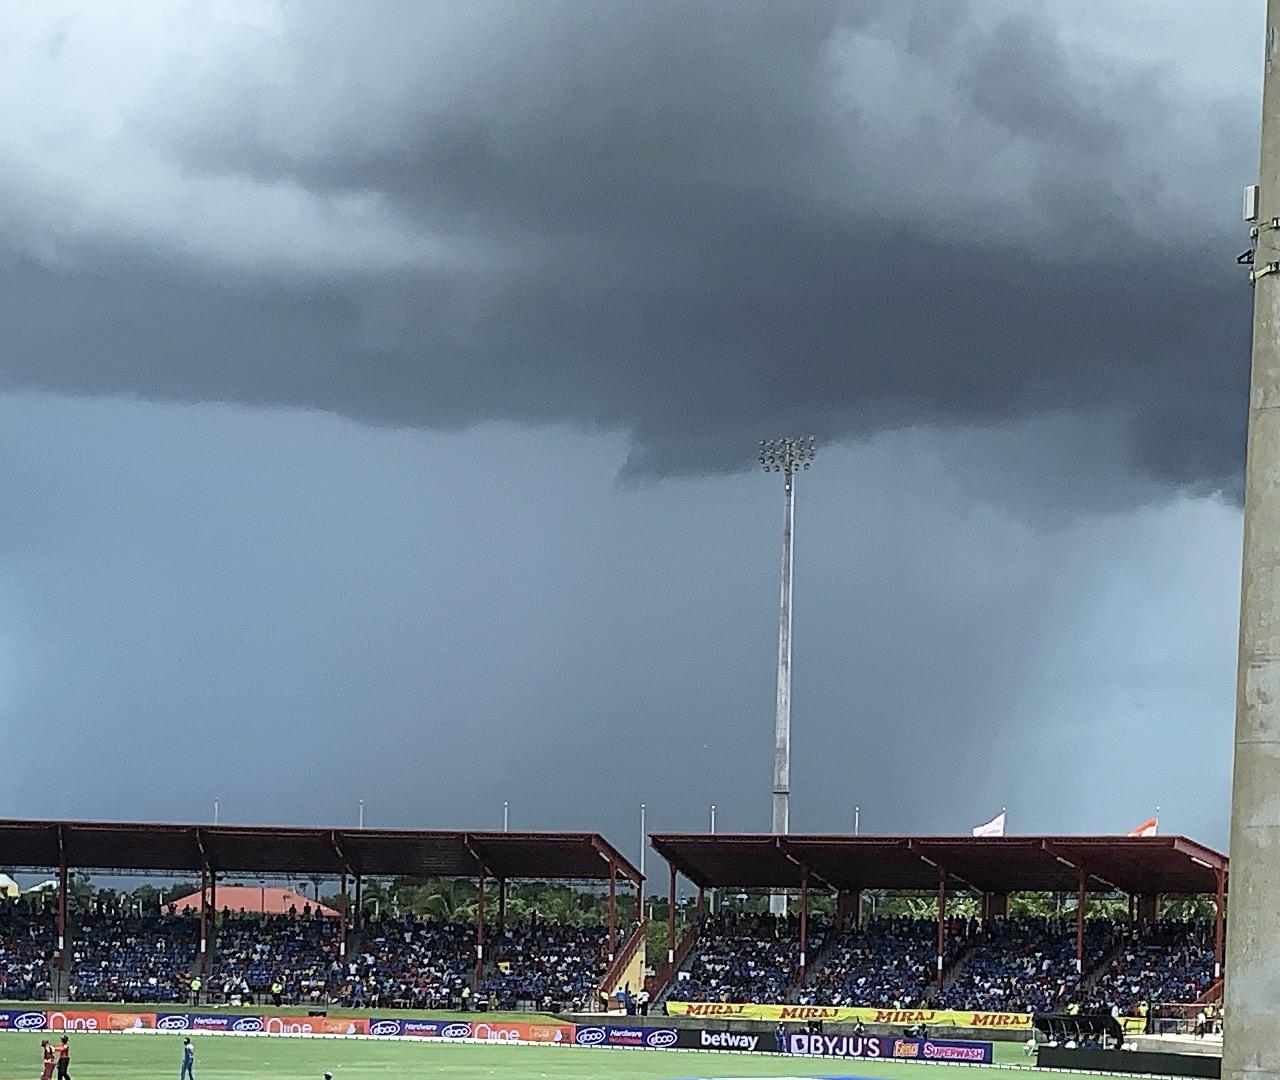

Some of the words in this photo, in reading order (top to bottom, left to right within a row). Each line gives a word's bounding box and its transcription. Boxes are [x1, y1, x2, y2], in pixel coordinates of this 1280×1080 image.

[686, 1004, 744, 1016] MIRAJ
[779, 1007, 839, 1020] MIRAJ
[874, 1010, 936, 1022] MIRAJ
[971, 1013, 1031, 1029] MIRAJ
[610, 1030, 642, 1038] Hardware
[701, 1031, 759, 1050] betway
[812, 1036, 881, 1058] BYJU'S
